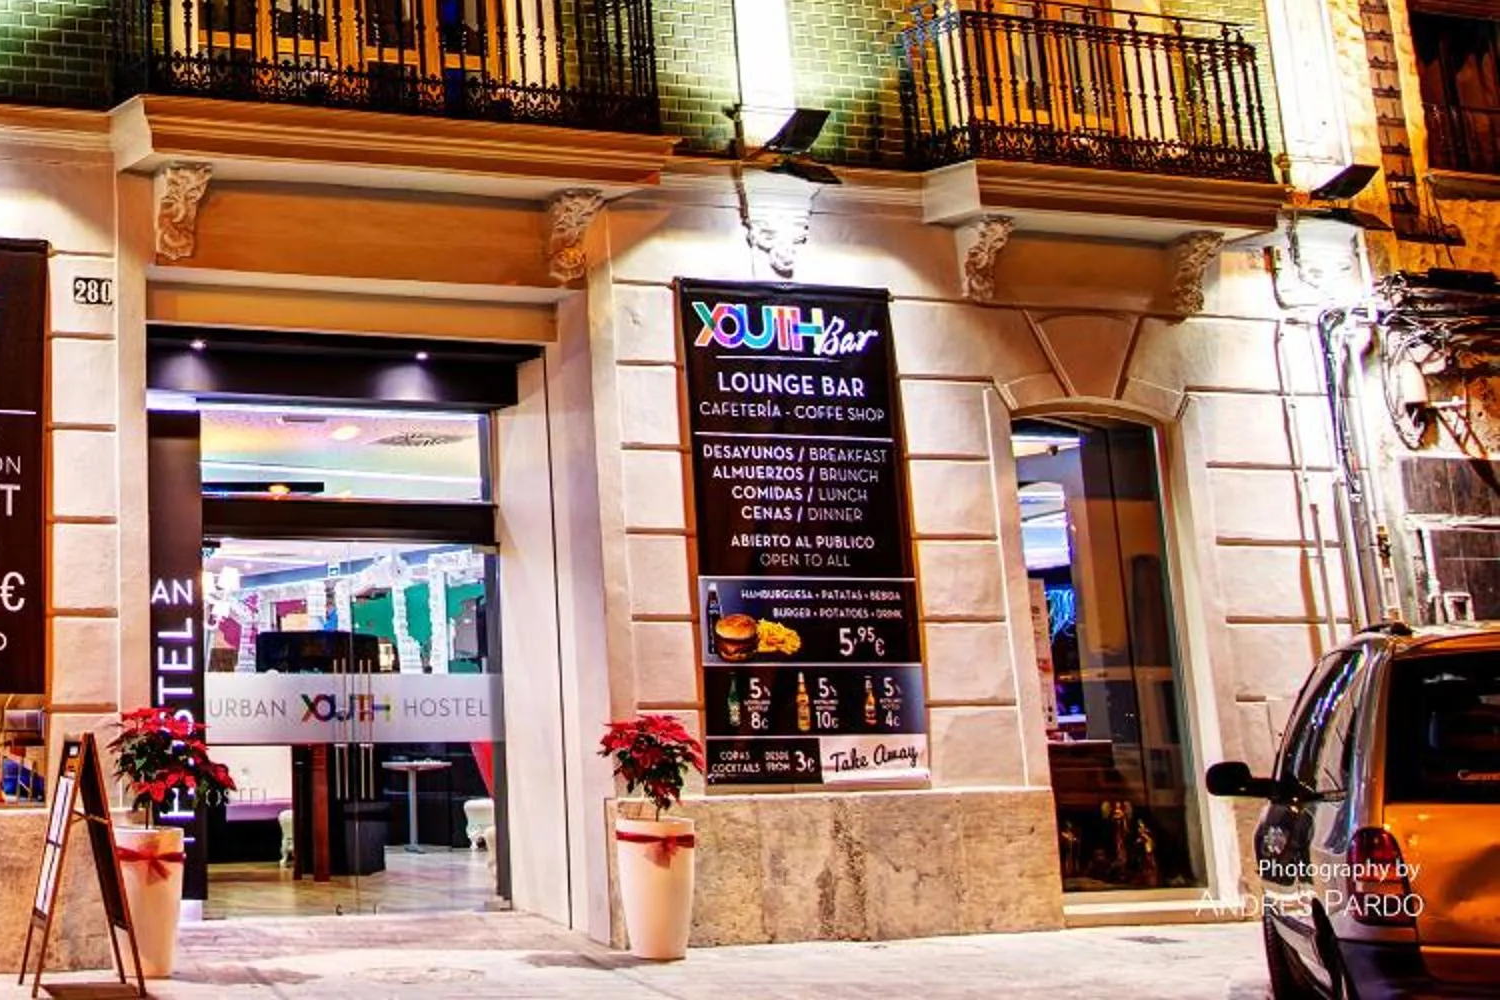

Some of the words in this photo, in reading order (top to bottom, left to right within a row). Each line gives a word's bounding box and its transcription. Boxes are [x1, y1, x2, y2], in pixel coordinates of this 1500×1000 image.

[74, 279, 112, 304] 280
[692, 302, 825, 355] YOUTH
[820, 316, 878, 355] Bar
[717, 371, 814, 394] LOUNGE
[822, 376, 865, 397] BAR
[700, 400, 781, 418] CAFETERÍA
[794, 405, 843, 421] COFFE
[847, 407, 885, 423] SHOP
[703, 443, 794, 460] DESAYUNOS
[809, 447, 887, 463] BREAKFAST
[712, 465, 804, 482] ALMUERZOS
[819, 467, 879, 484] BRUNCH
[731, 485, 803, 501] COMIDAS
[818, 487, 868, 502] LUNCH
[741, 505, 793, 521] CENAS
[808, 507, 863, 521] DINNER
[731, 533, 791, 548] ABIERTO
[795, 535, 812, 548] AL
[816, 535, 875, 549] PUBLICO
[759, 553, 799, 567] OPEN
[804, 553, 823, 567] TO
[827, 554, 851, 567] ALL
[209, 698, 287, 718] URBAN
[403, 698, 488, 718] HOSTEL
[829, 748, 869, 773] Take
[873, 744, 918, 768] Away
